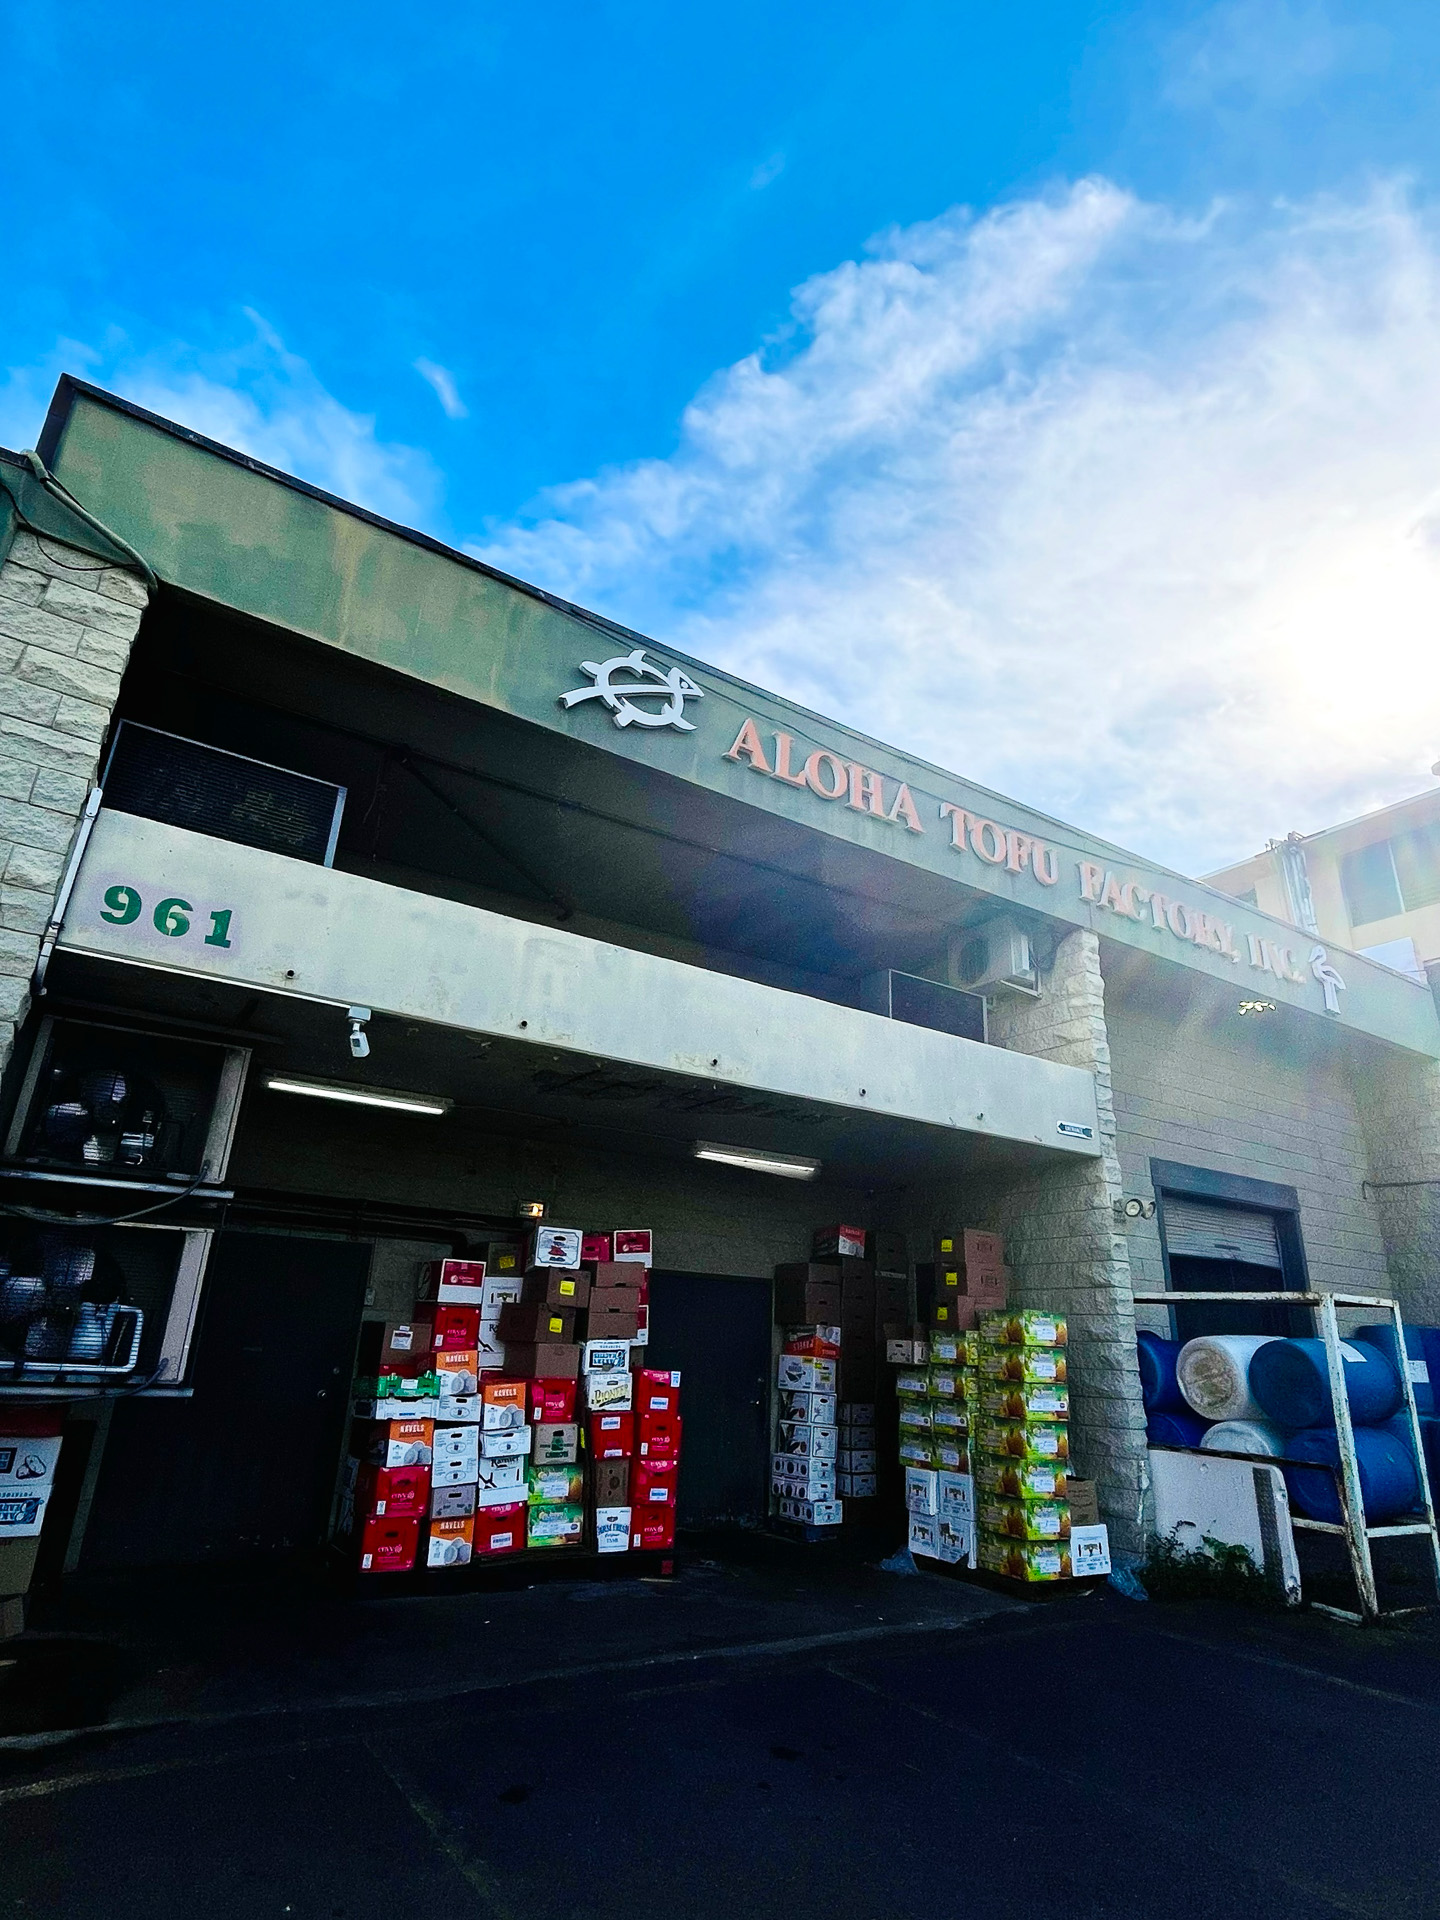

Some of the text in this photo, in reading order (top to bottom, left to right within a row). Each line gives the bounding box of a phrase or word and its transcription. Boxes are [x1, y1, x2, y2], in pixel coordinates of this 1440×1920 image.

[721, 717, 925, 834] ALOHA
[939, 802, 1059, 886] TOFU
[100, 885, 233, 949] 961
